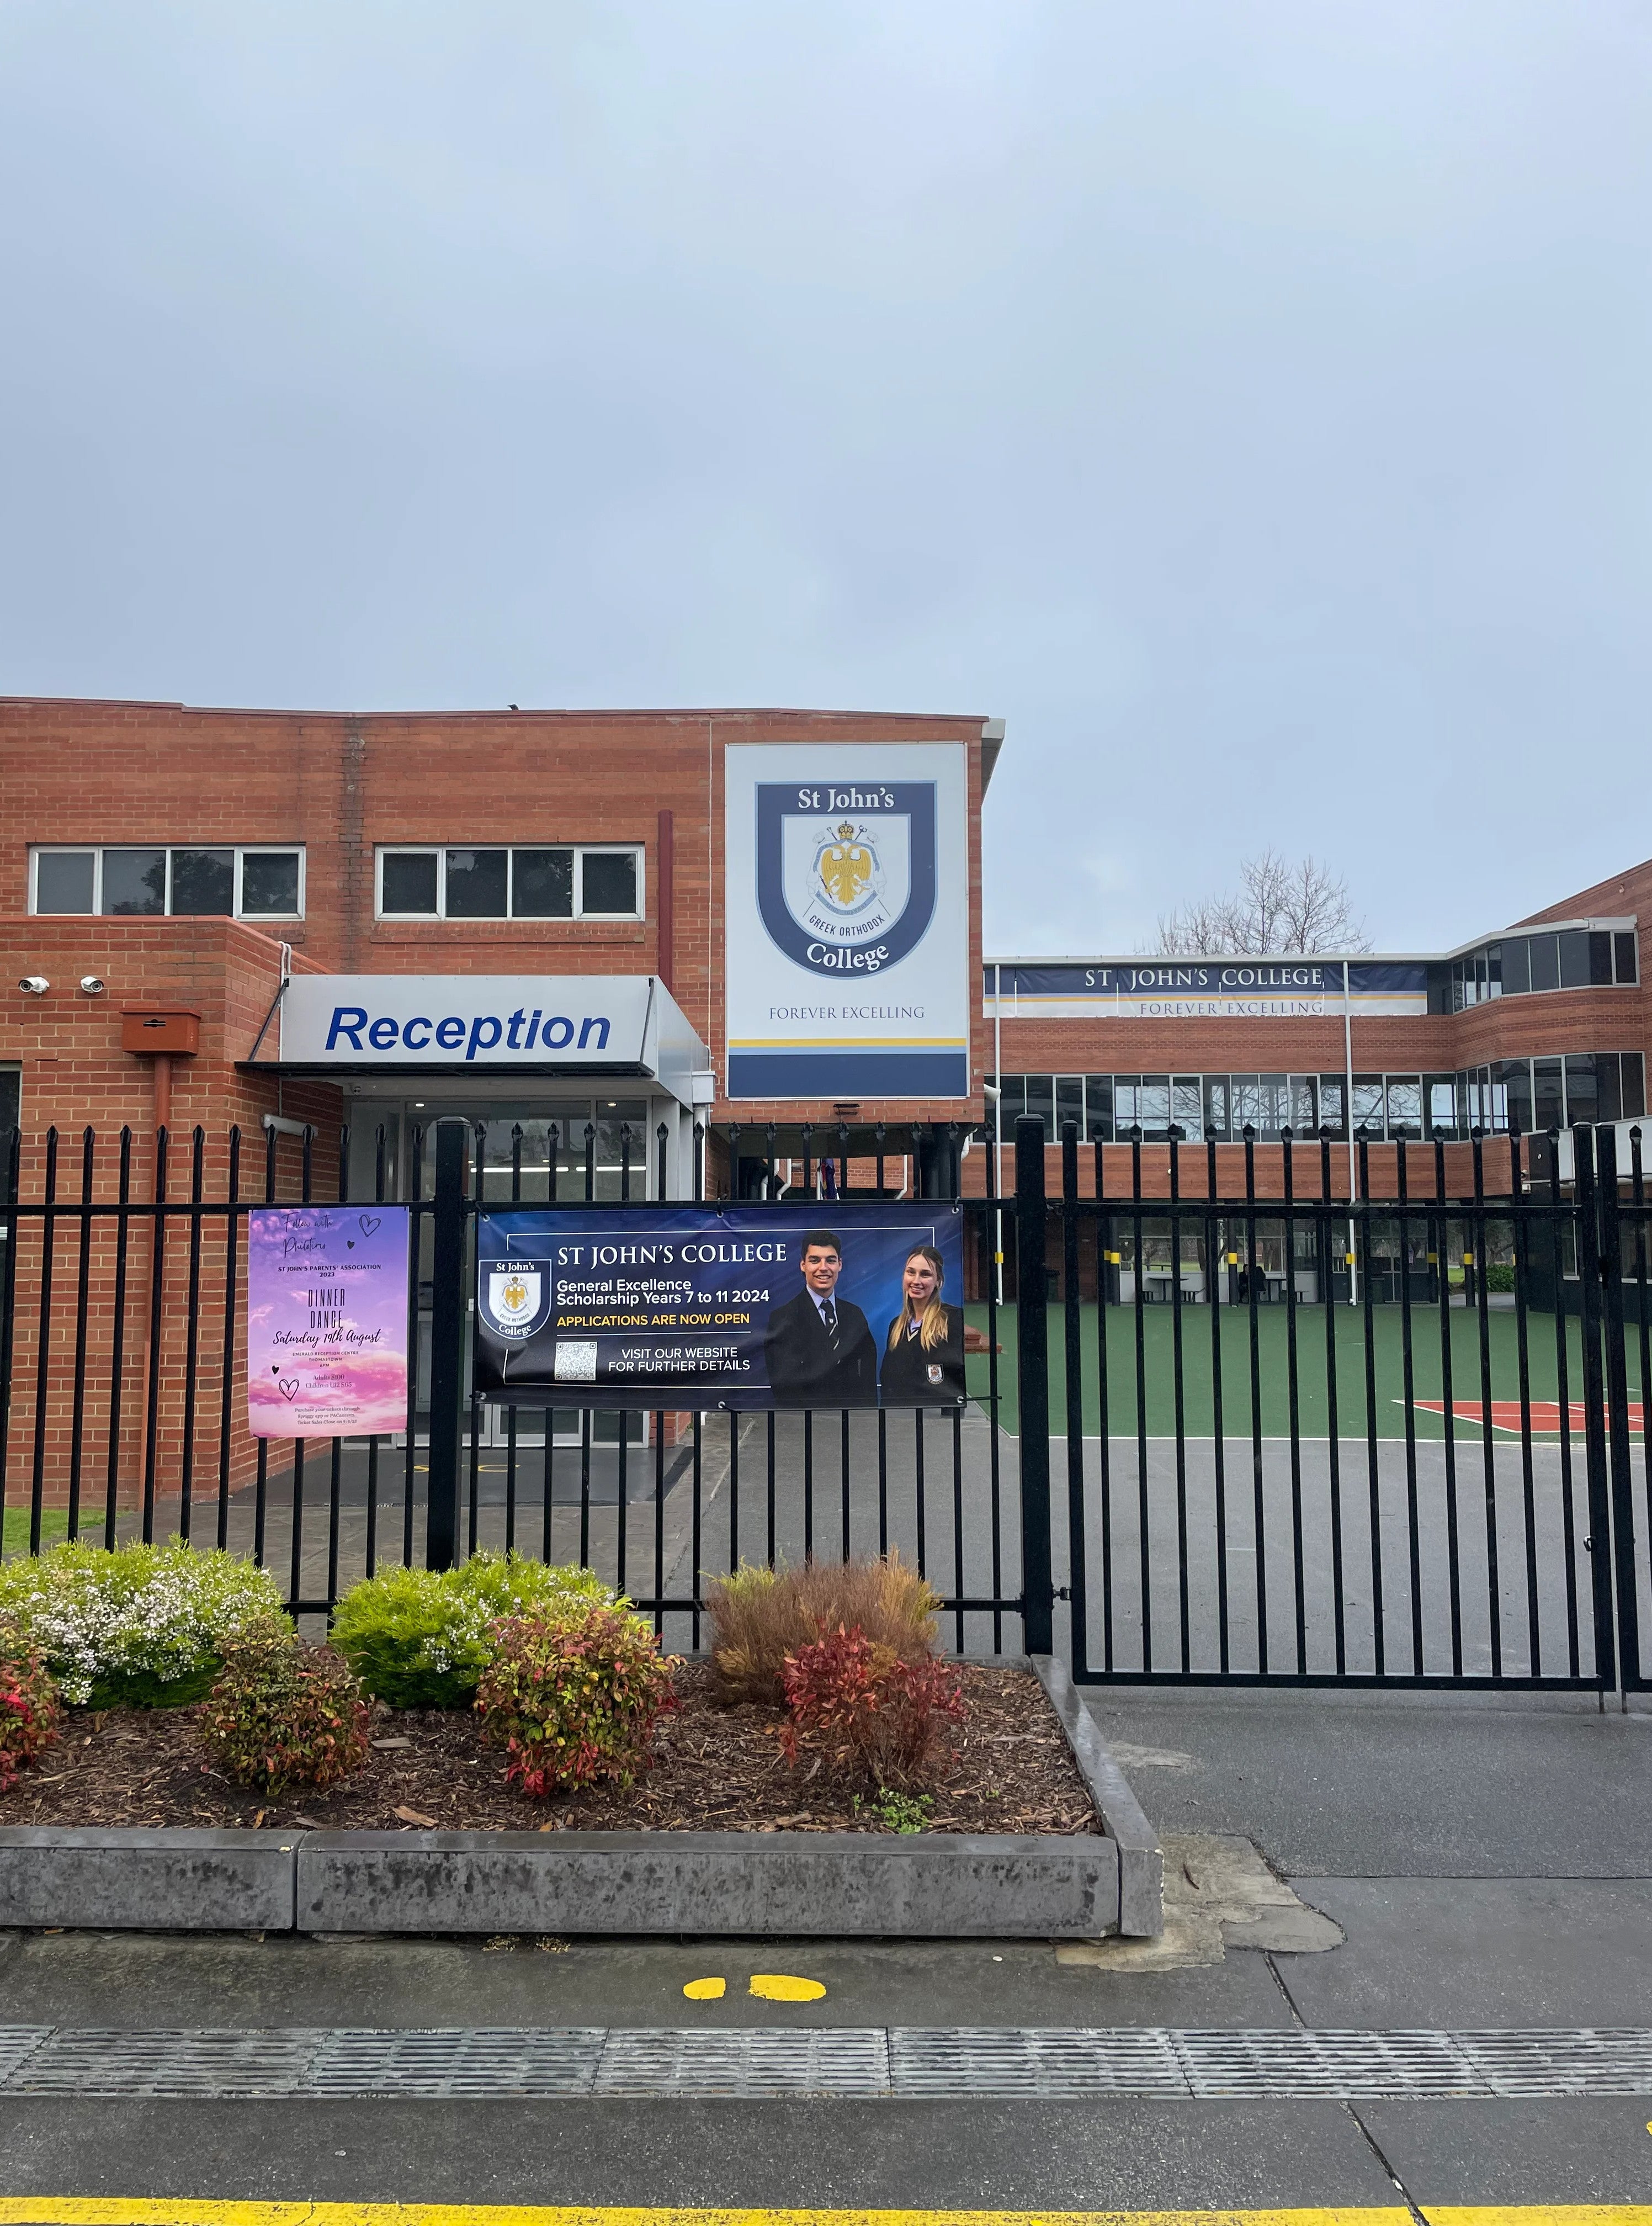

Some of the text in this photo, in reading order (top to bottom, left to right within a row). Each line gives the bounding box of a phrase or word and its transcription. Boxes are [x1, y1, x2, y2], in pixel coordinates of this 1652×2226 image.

[798, 787, 895, 812] St John's
[809, 914, 886, 937] GREEK ORTHODOX
[806, 942, 889, 971] College
[1085, 968, 1322, 992] ST JOHN'S COLLEGE
[769, 1006, 925, 1020] FOREVER EXCELLING
[1140, 1001, 1323, 1015] FOREVER EXCELLING
[325, 1007, 610, 1060] Reception
[557, 1243, 787, 1270] ST JOHN'S COLLEGE
[496, 1262, 535, 1273] St John's
[556, 1278, 692, 1293] General Excellence
[308, 1289, 345, 1307] DINNER
[556, 1290, 770, 1307] Scholarship Years 7 to 11 2024
[310, 1310, 343, 1329] DANCE
[556, 1313, 750, 1327] APPLICATIONS ARE NOW OPEN
[273, 1326, 381, 1348] Saturday 19th August
[498, 1324, 532, 1336] College
[622, 1347, 738, 1359] VISIT OUR WEBSITE
[608, 1359, 750, 1372] FOR FURTHER DETAILS
